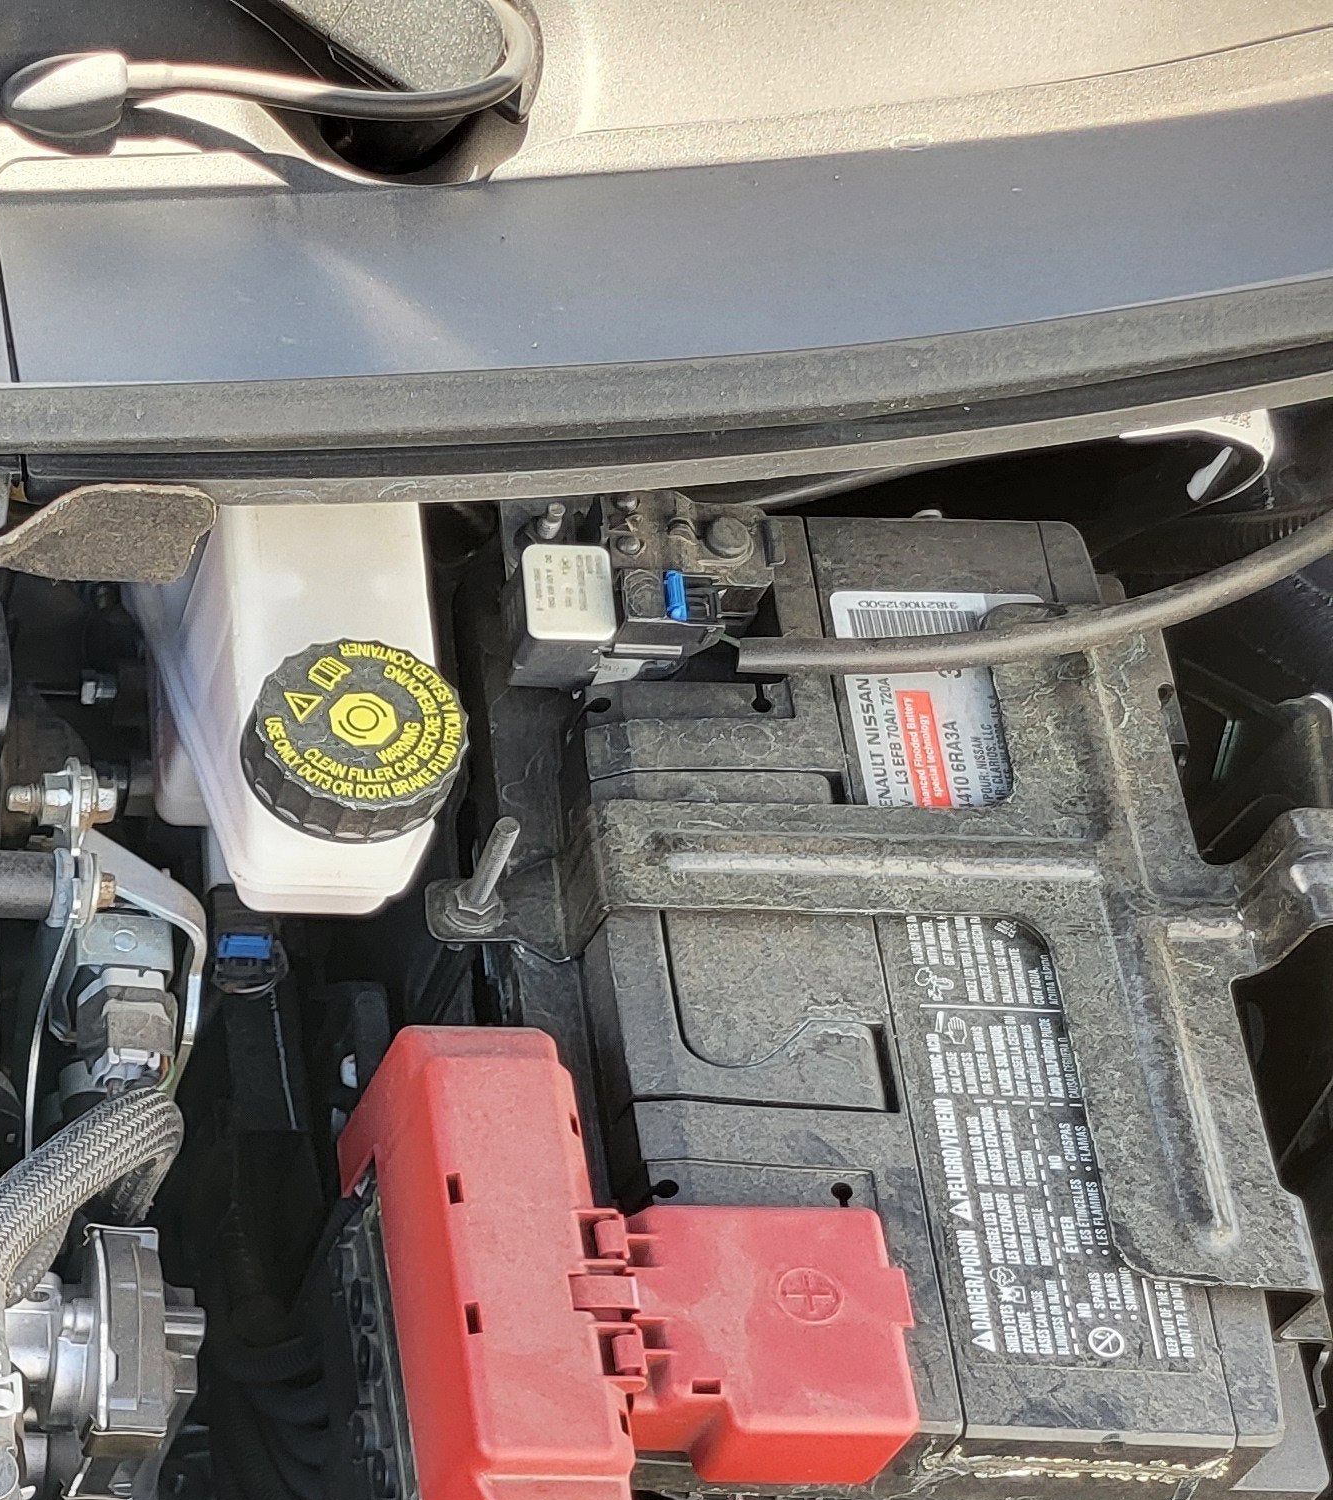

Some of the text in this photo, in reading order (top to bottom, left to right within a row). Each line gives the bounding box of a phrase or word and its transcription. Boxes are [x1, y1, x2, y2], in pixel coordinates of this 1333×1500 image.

[877, 678, 894, 705] 720A
[265, 643, 461, 799] USE ONLY DOT3 OR DOT4 BRAKE FLUID FROM A SEALED CONTAINER
[304, 665, 441, 782] CLEAN FILLER CAP BEFORE REMOVING
[855, 678, 881, 745] NISSAN
[885, 709, 899, 738] 70Ah
[903, 697, 918, 729] Battery
[376, 722, 421, 765] WARNING
[909, 731, 924, 767] Flooded
[942, 721, 966, 772] 6RA3A
[981, 724, 994, 740] LLC
[889, 743, 904, 766] EFB
[918, 713, 944, 797] special technology
[970, 736, 987, 769] NISSAN
[894, 770, 908, 784] L3
[927, 946, 940, 965] WITH
[943, 952, 955, 965] GET
[926, 1033, 949, 1093] SULFURIC ACID
[945, 1051, 964, 1094] CAN CAUSE
[960, 1052, 979, 1094] BLINDNESS
[975, 1053, 992, 1081] SEVERE
[982, 1083, 994, 1095] OR
[966, 1116, 982, 1134] OJOS
[933, 1098, 968, 1200] PELIGRO/VENENO
[971, 1135, 984, 1151] LOS
[1059, 1123, 1077, 1162] CHISPAS
[1074, 1125, 1092, 1162] FLAMAS
[1048, 1155, 1062, 1170] NO
[983, 1212, 997, 1225] LES
[995, 1193, 1021, 1265] LES GAZ EXPLOSIFS
[1070, 1179, 1093, 1245] LES ÉTINCELLES
[1086, 1181, 1109, 1246] LES FLAMMES
[1020, 1235, 1037, 1265] PEUVENT
[1060, 1216, 1079, 1253] ÉVITER
[956, 1229, 991, 1330] DANGER/POISON
[1088, 1272, 1105, 1309] SPARKS
[1104, 1272, 1122, 1310] FLAMES
[1118, 1267, 1138, 1311] SMOKING
[1049, 1305, 1062, 1315] OR
[1076, 1302, 1092, 1318] NO
[1156, 1288, 1169, 1306] THE
[1159, 1308, 1172, 1318] OF
[1172, 1299, 1186, 1312] DO
[1000, 1304, 1021, 1353] SHIELD EYES
[1018, 1311, 1036, 1354] EXPLOSIVE
[1031, 1290, 1053, 1354] GASES CAN CAUSE
[1051, 1316, 1069, 1355] BLINDNESS
[1162, 1320, 1175, 1336] OUT
[1177, 1328, 1192, 1345] NOT
[1165, 1338, 1180, 1357] KEEP
[1181, 1346, 1195, 1358] DO
